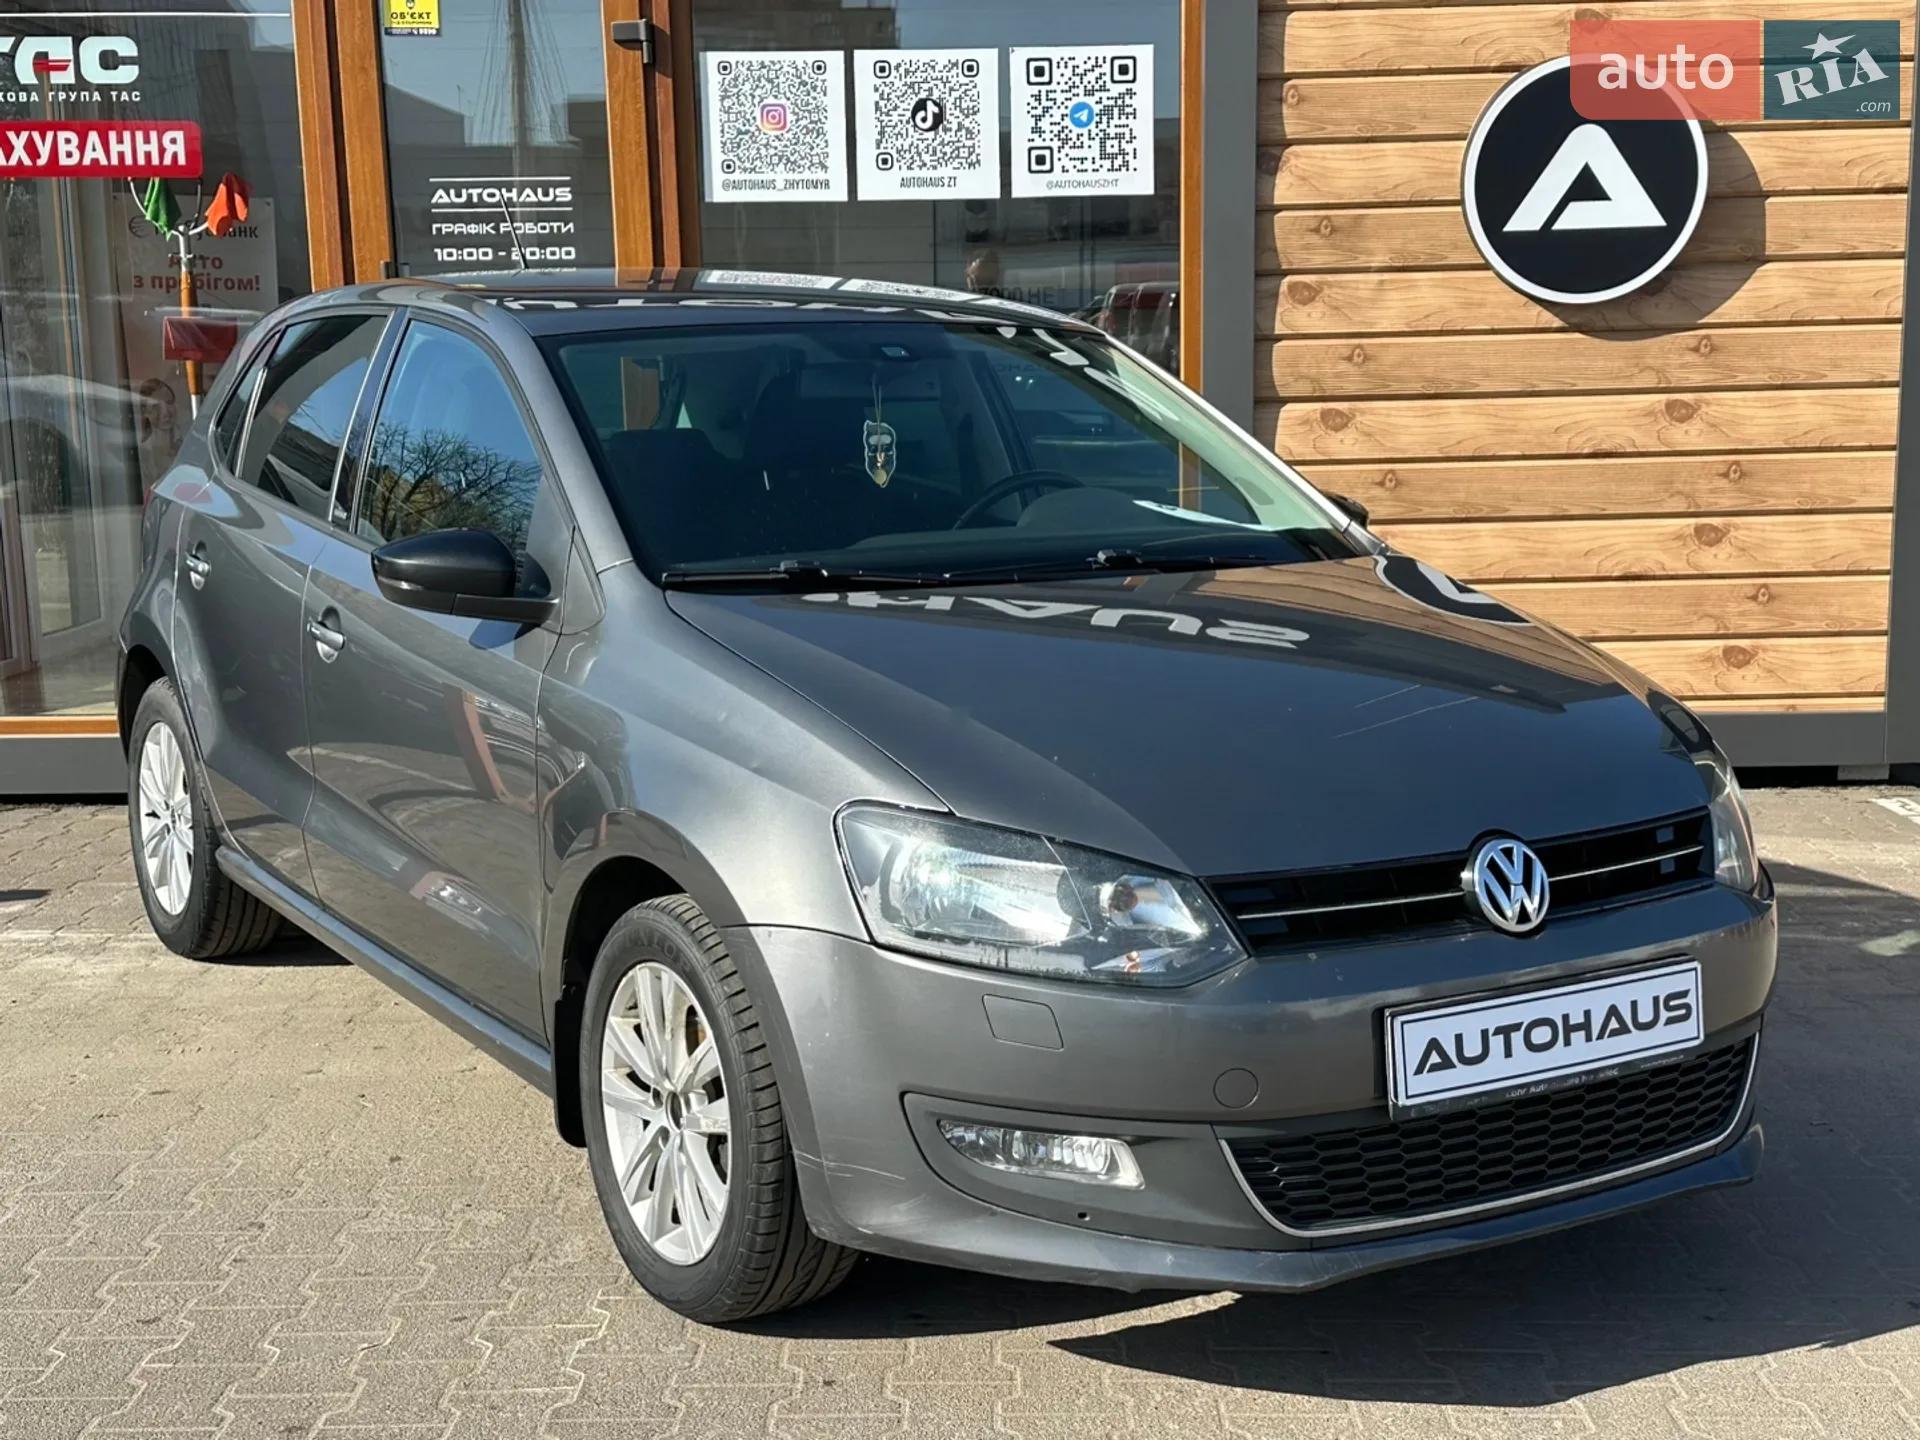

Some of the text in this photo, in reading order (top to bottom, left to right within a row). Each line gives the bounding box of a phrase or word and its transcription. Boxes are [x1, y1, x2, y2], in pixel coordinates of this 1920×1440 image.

[48, 91, 101, 102] ГРУПА
[110, 91, 142, 102] ТАС
[721, 178, 831, 192] @AUTOHAUS_ZHYTOMYR
[899, 175, 958, 189] AUTOHAUS ZT
[430, 186, 573, 204] AUTOHAUS
[431, 221, 575, 236] ГРАФІК РОБОТИ
[167, 253, 223, 270] Ато
[433, 247, 494, 262] 10:00
[510, 246, 577, 261] 20:00
[151, 272, 260, 293] прбігом!
[1413, 989, 1692, 1076] AUTOHAUS
